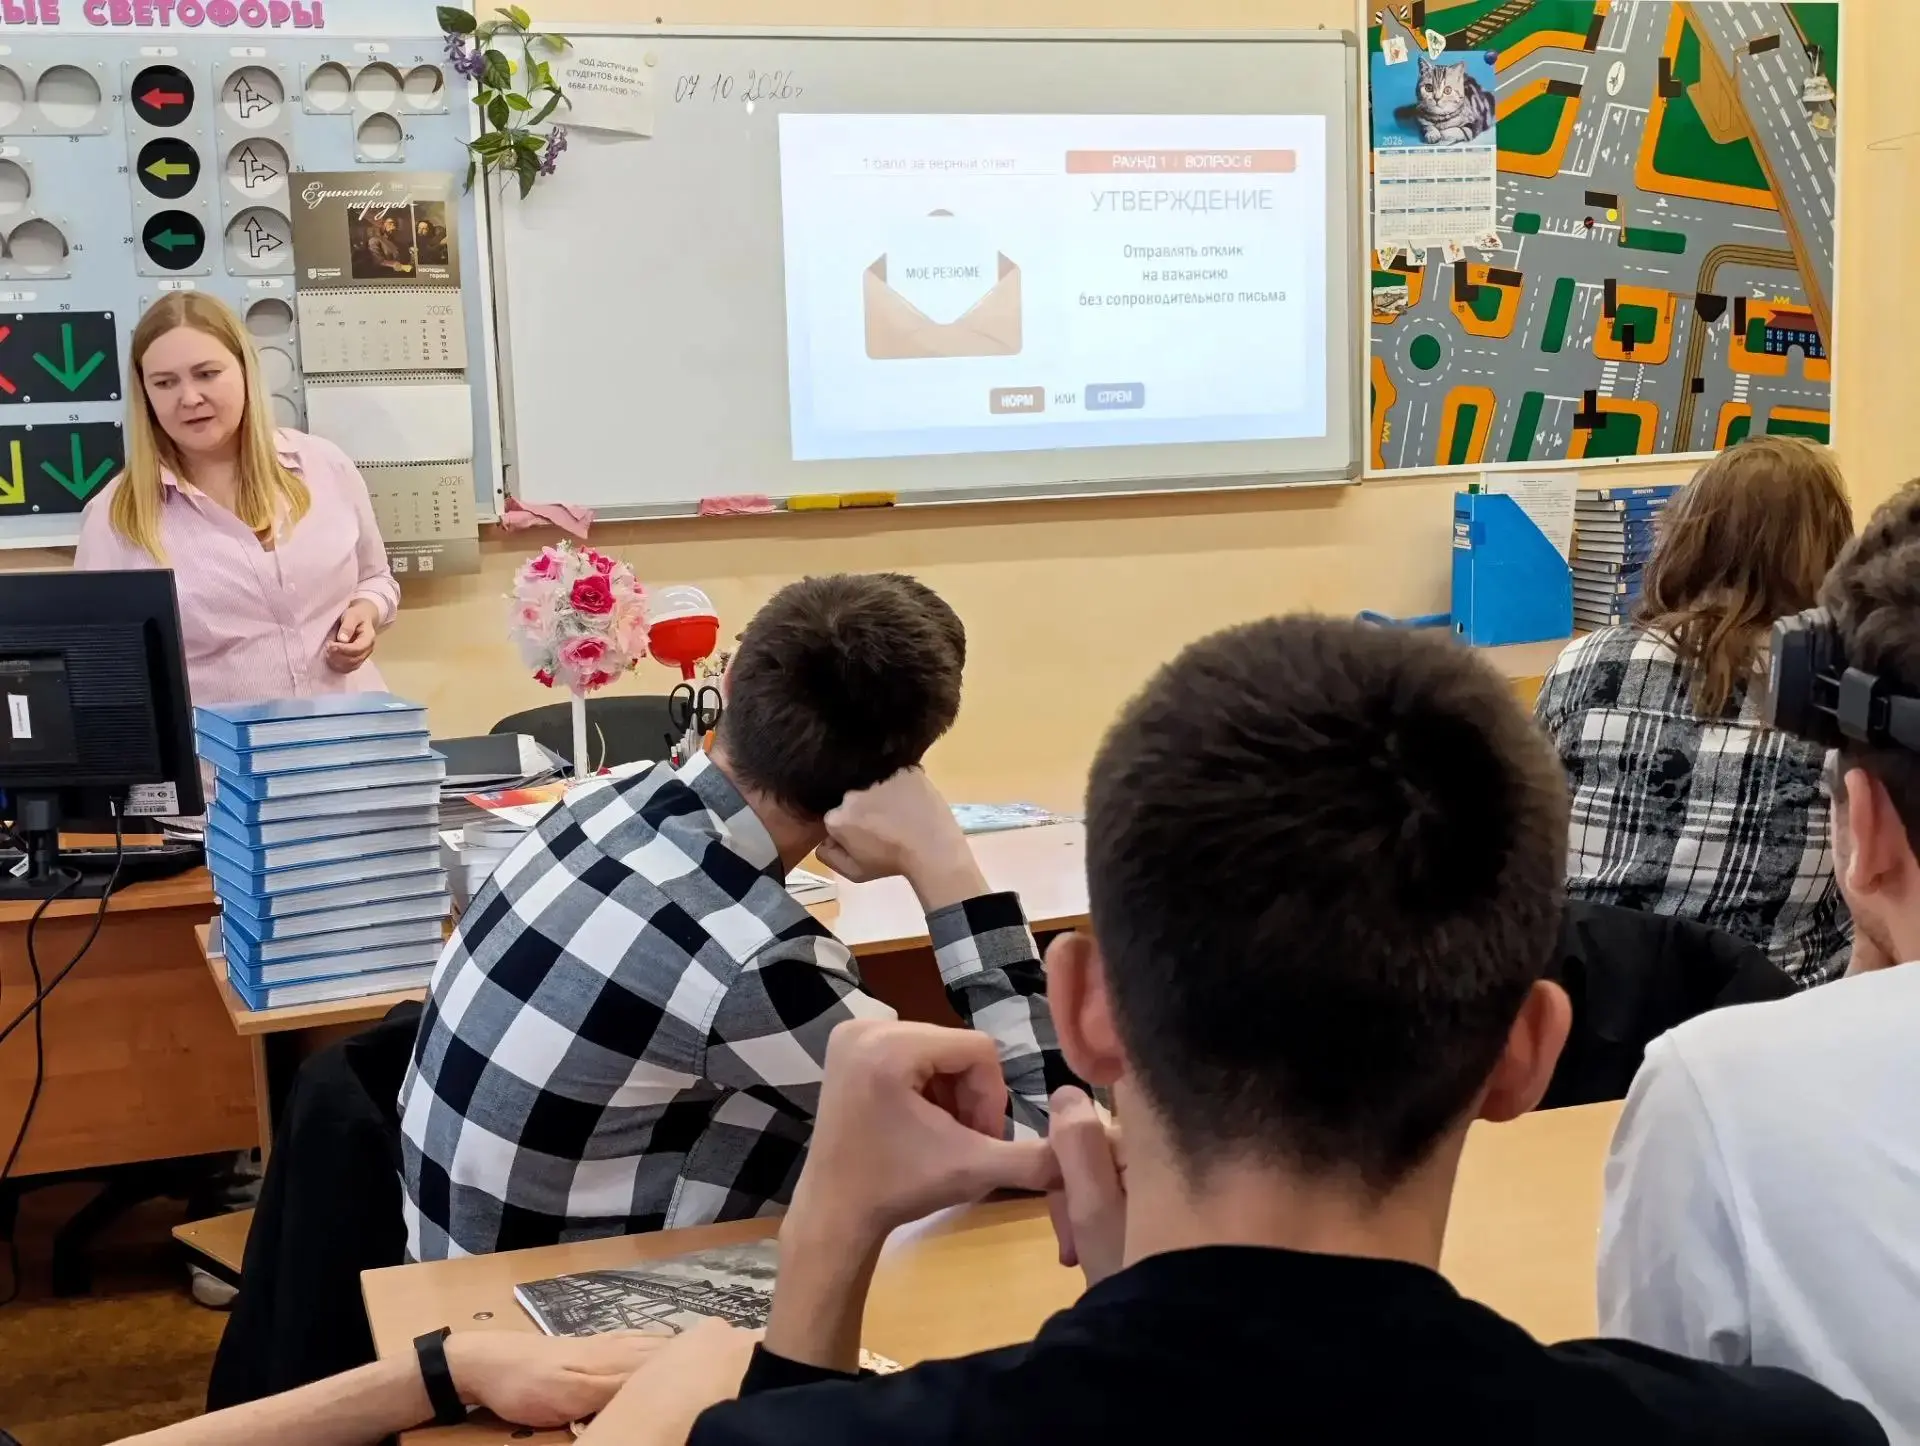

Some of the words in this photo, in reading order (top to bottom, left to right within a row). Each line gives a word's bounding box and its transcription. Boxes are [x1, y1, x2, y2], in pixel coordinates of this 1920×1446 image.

[0, 0, 60, 25] ЫЕ
[83, 0, 324, 28] СВЕТОФОРЫ
[711, 73, 734, 103] 10
[1111, 155, 1156, 170] РАУНД
[1185, 154, 1241, 168] ВОПРОС
[1244, 155, 1253, 168] 6
[301, 181, 384, 209] Единство
[1091, 189, 1273, 214] УТВЕРЖДЕНИЕ
[347, 192, 416, 221] народов
[1123, 244, 1198, 260] Отправлять
[1201, 245, 1244, 257] отклик
[933, 266, 981, 279] РЕЗЮМЕ
[1142, 269, 1158, 281] на
[1162, 267, 1229, 281] вакансию
[1079, 291, 1102, 306] без
[1106, 291, 1235, 308] сопроводительного
[1238, 290, 1287, 304] письма
[425, 304, 453, 316] 2026
[1002, 393, 1034, 408] НОРМ
